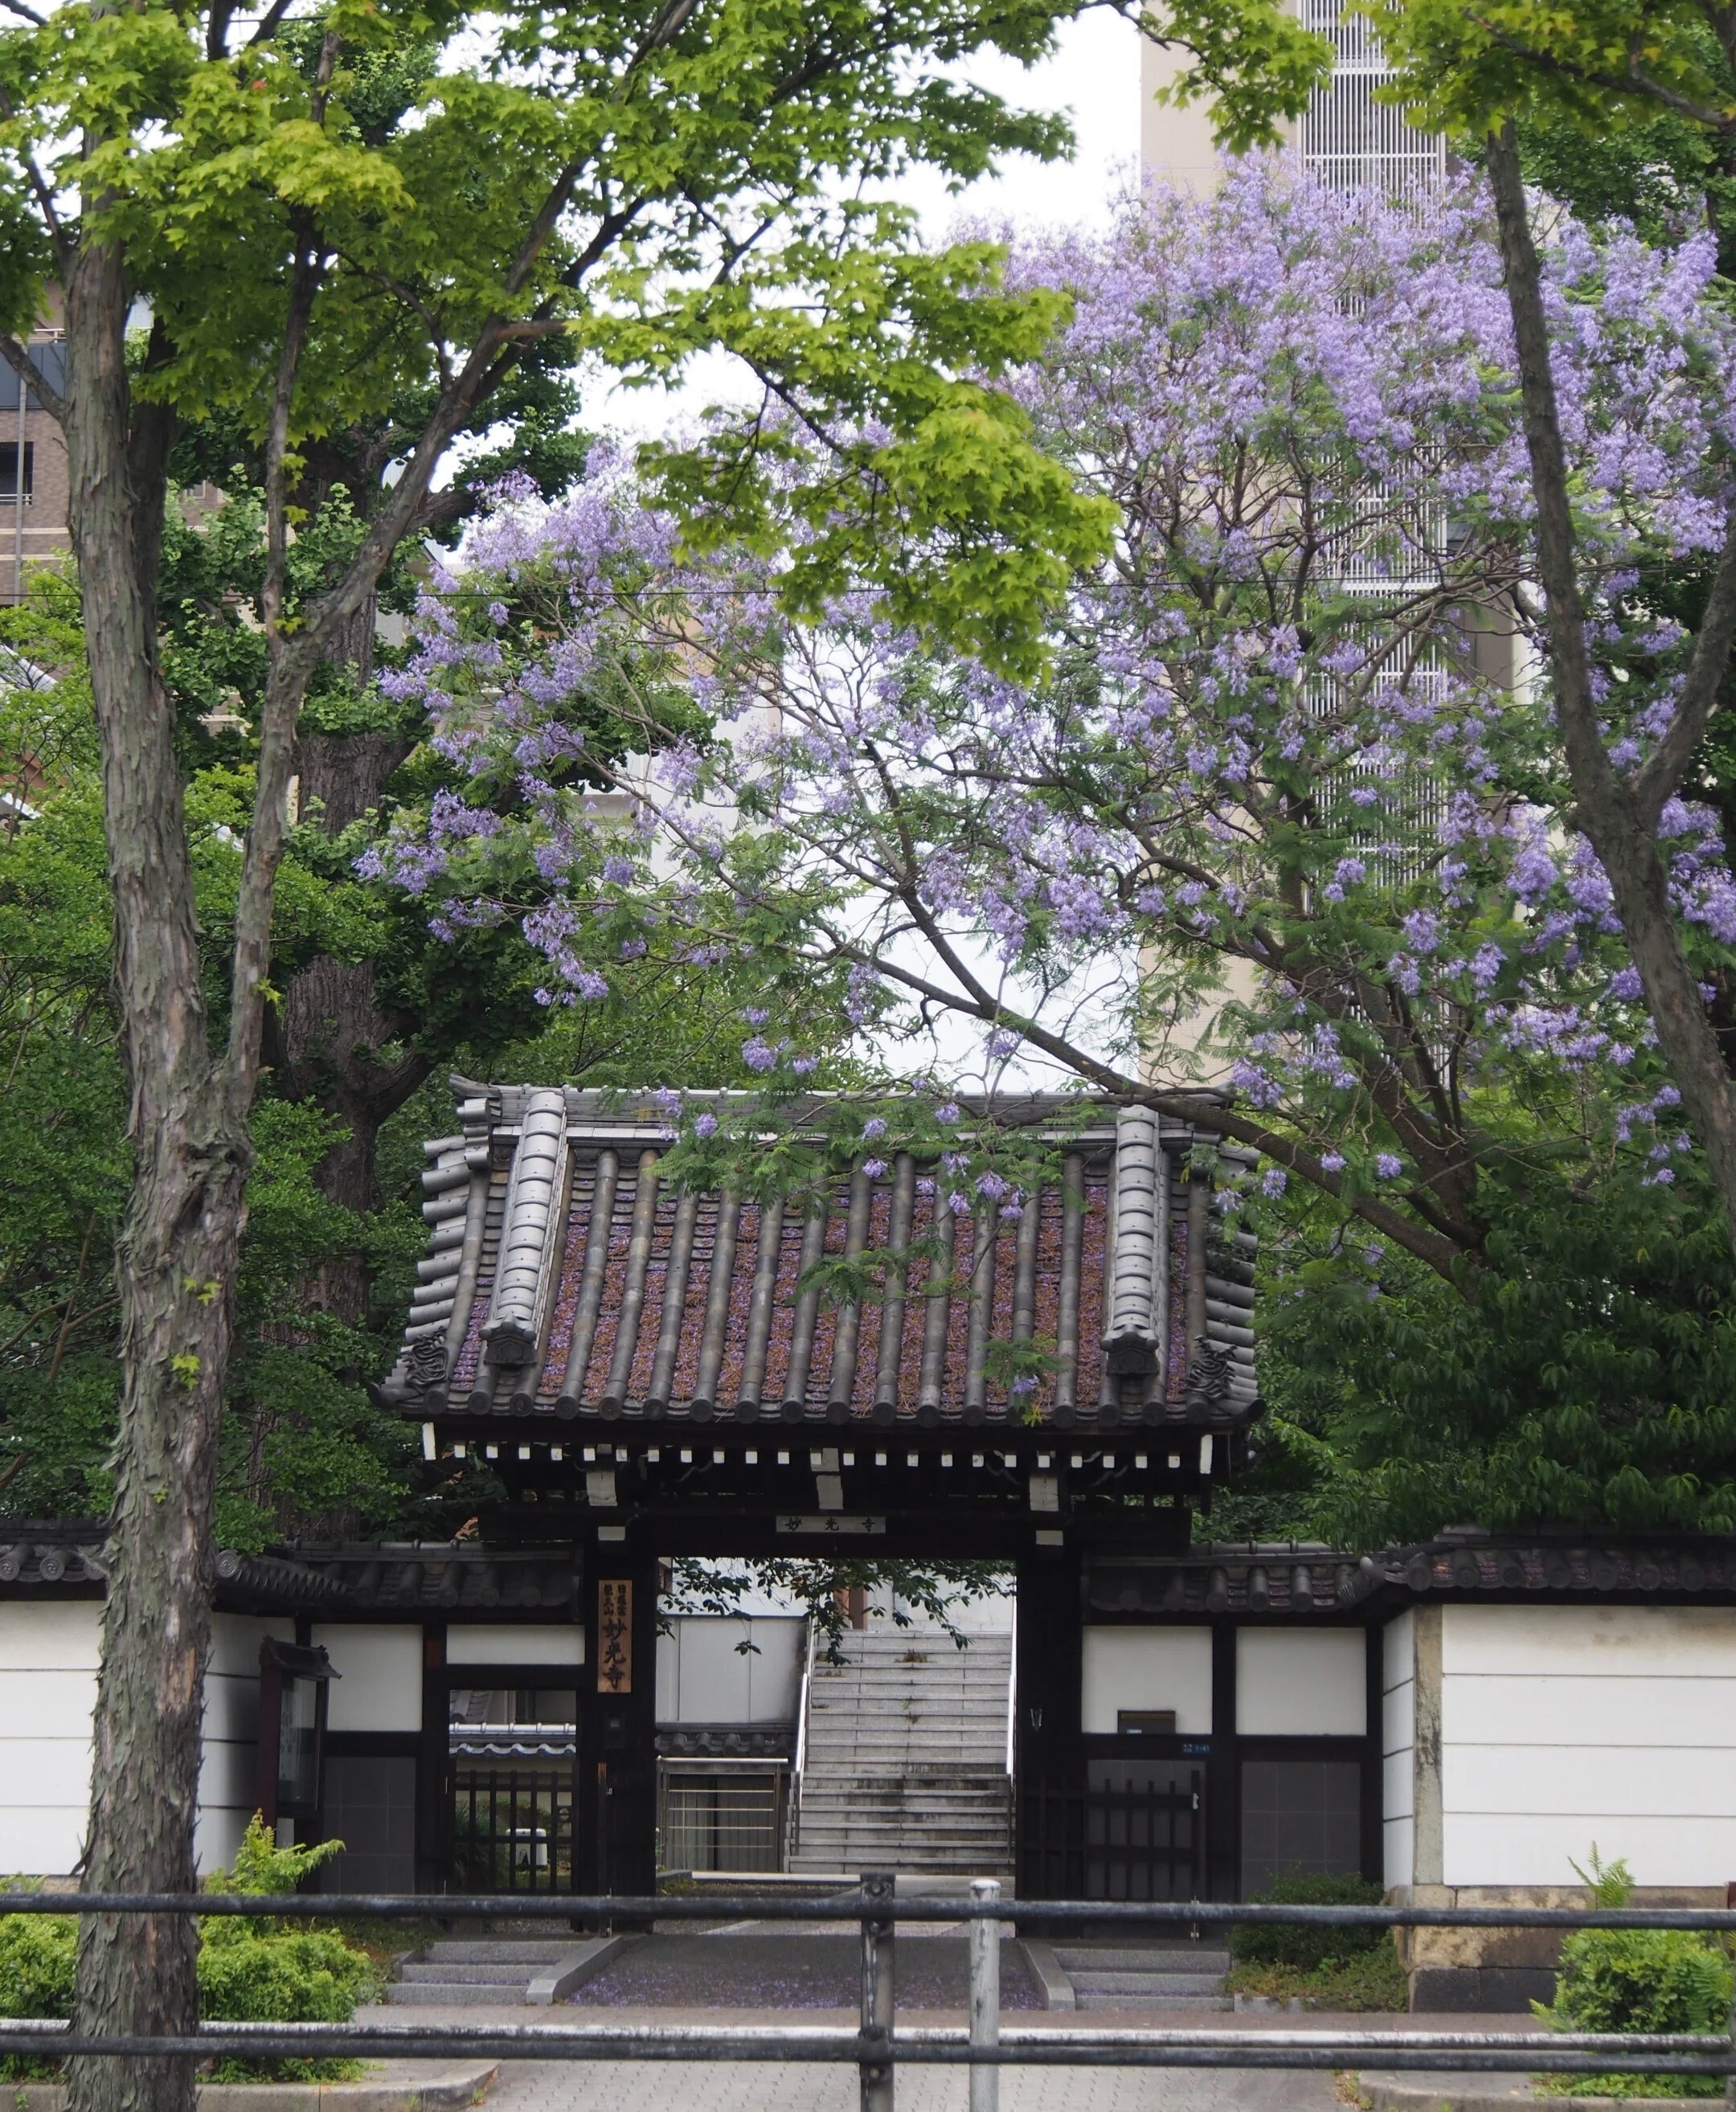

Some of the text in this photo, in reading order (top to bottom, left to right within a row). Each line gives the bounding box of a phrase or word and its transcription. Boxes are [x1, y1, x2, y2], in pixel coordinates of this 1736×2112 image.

[785, 1516, 875, 1532] 妙光寺
[602, 1618, 627, 1691] 妙光寺
